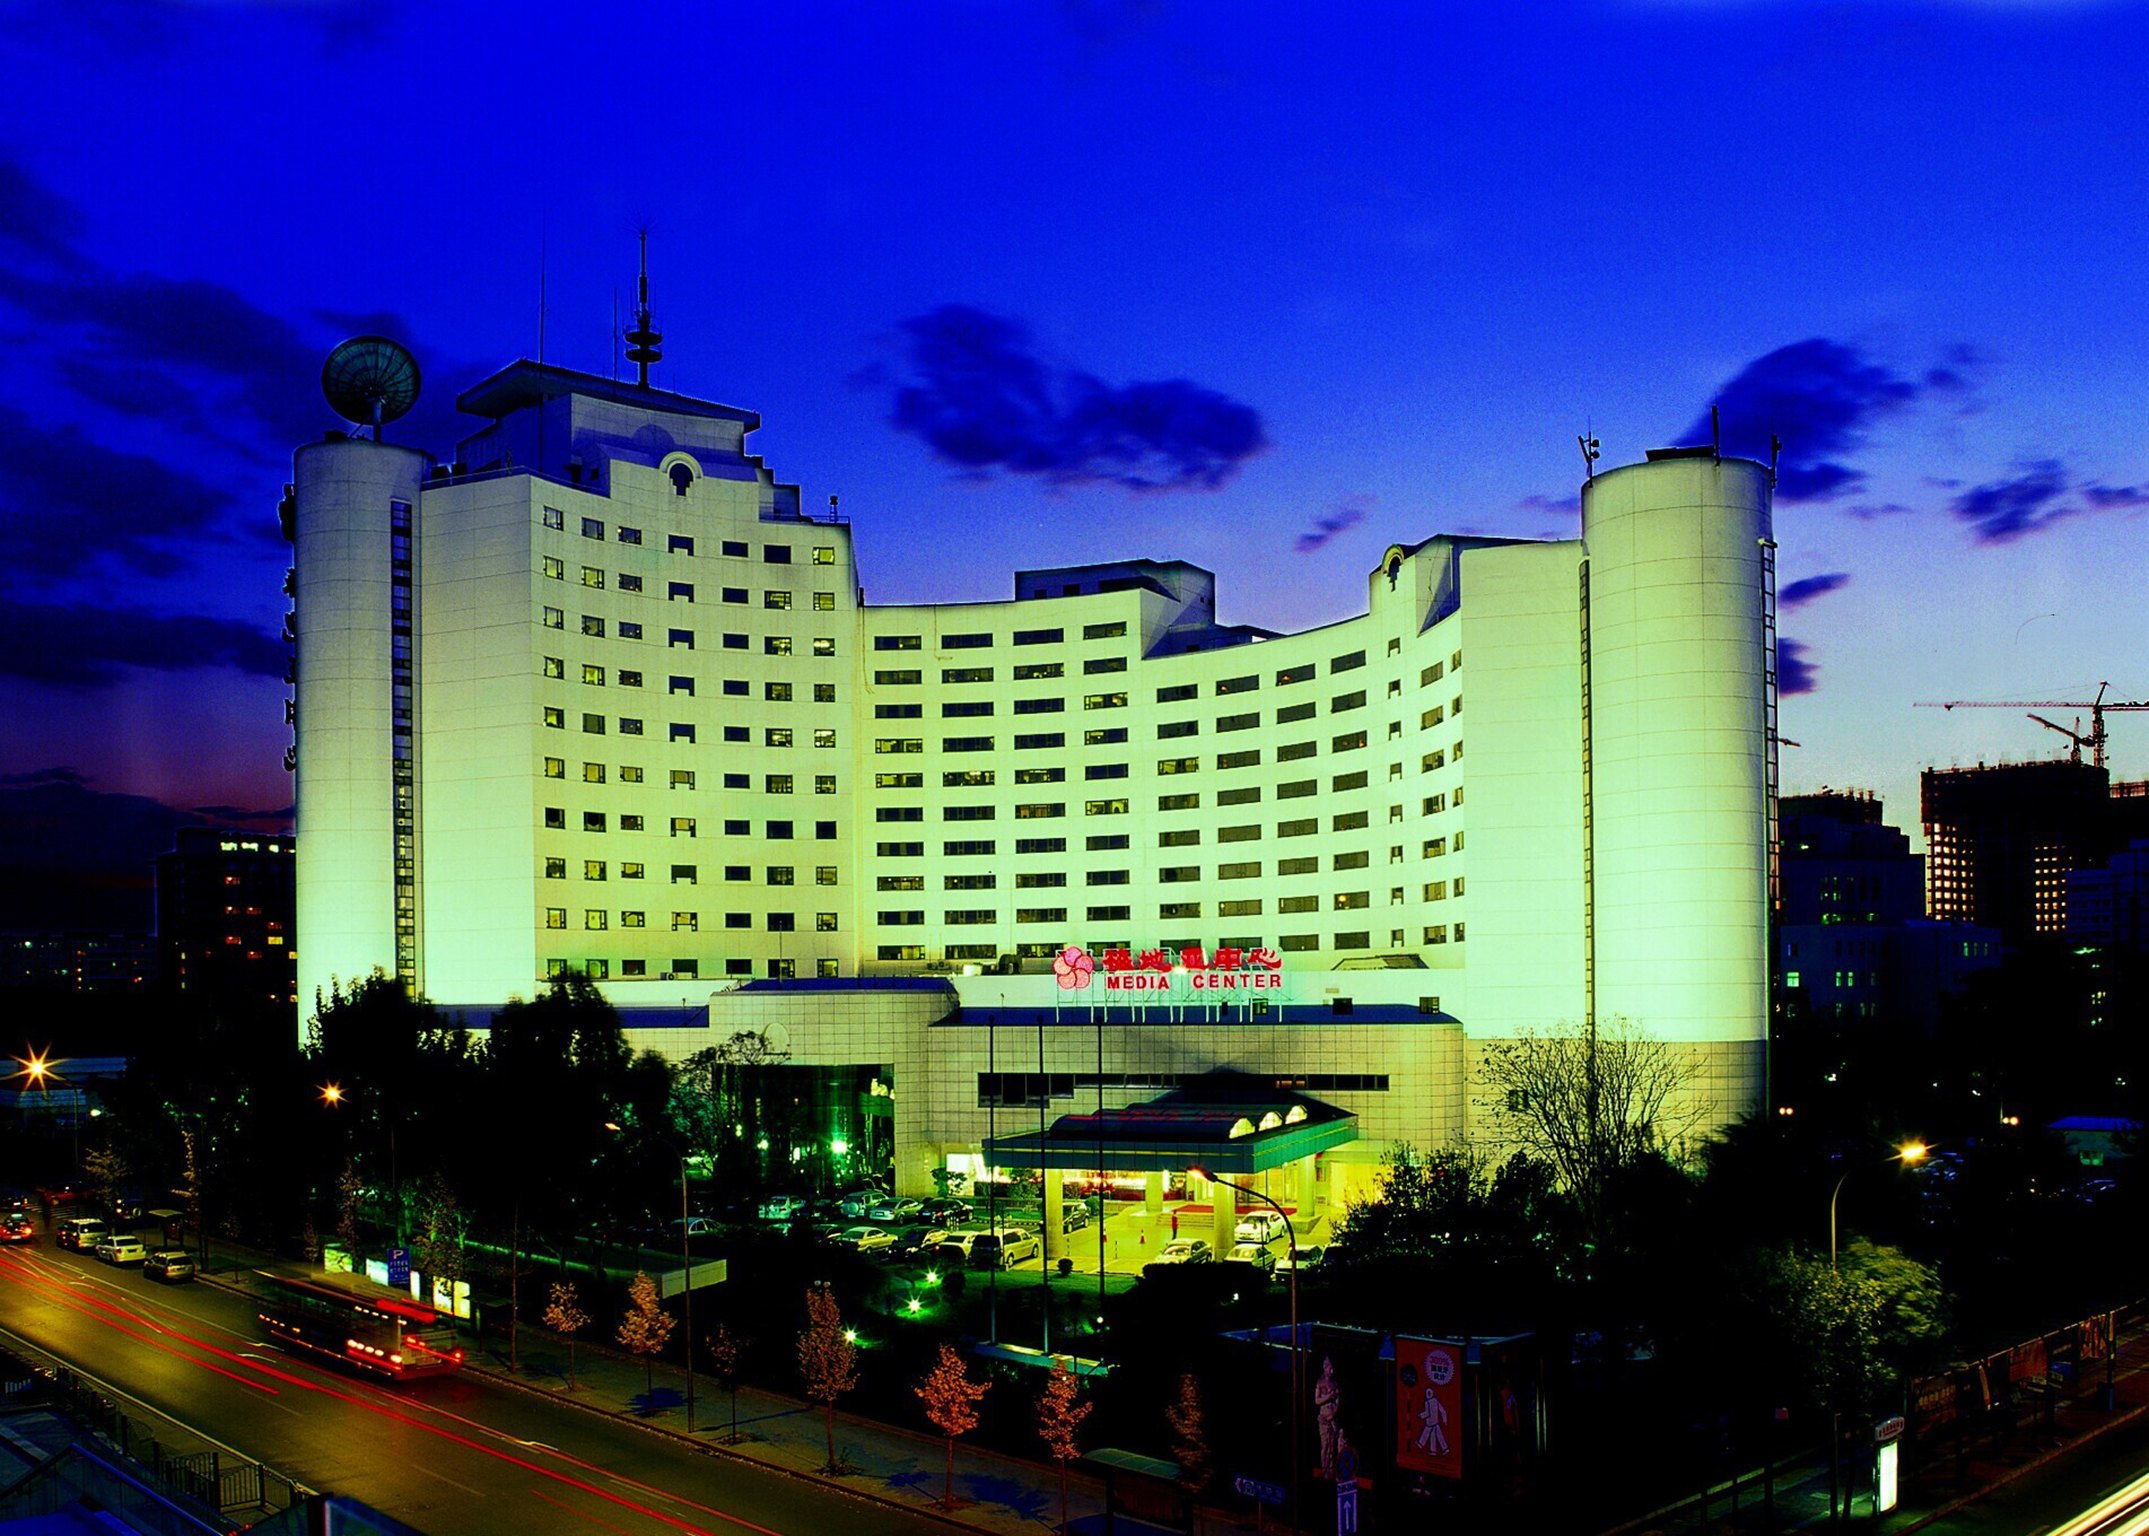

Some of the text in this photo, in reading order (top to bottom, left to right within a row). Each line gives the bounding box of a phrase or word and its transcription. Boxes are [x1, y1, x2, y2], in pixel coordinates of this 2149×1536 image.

[1107, 973, 1282, 990] MEDIA CENTER
[393, 1249, 404, 1260] P
